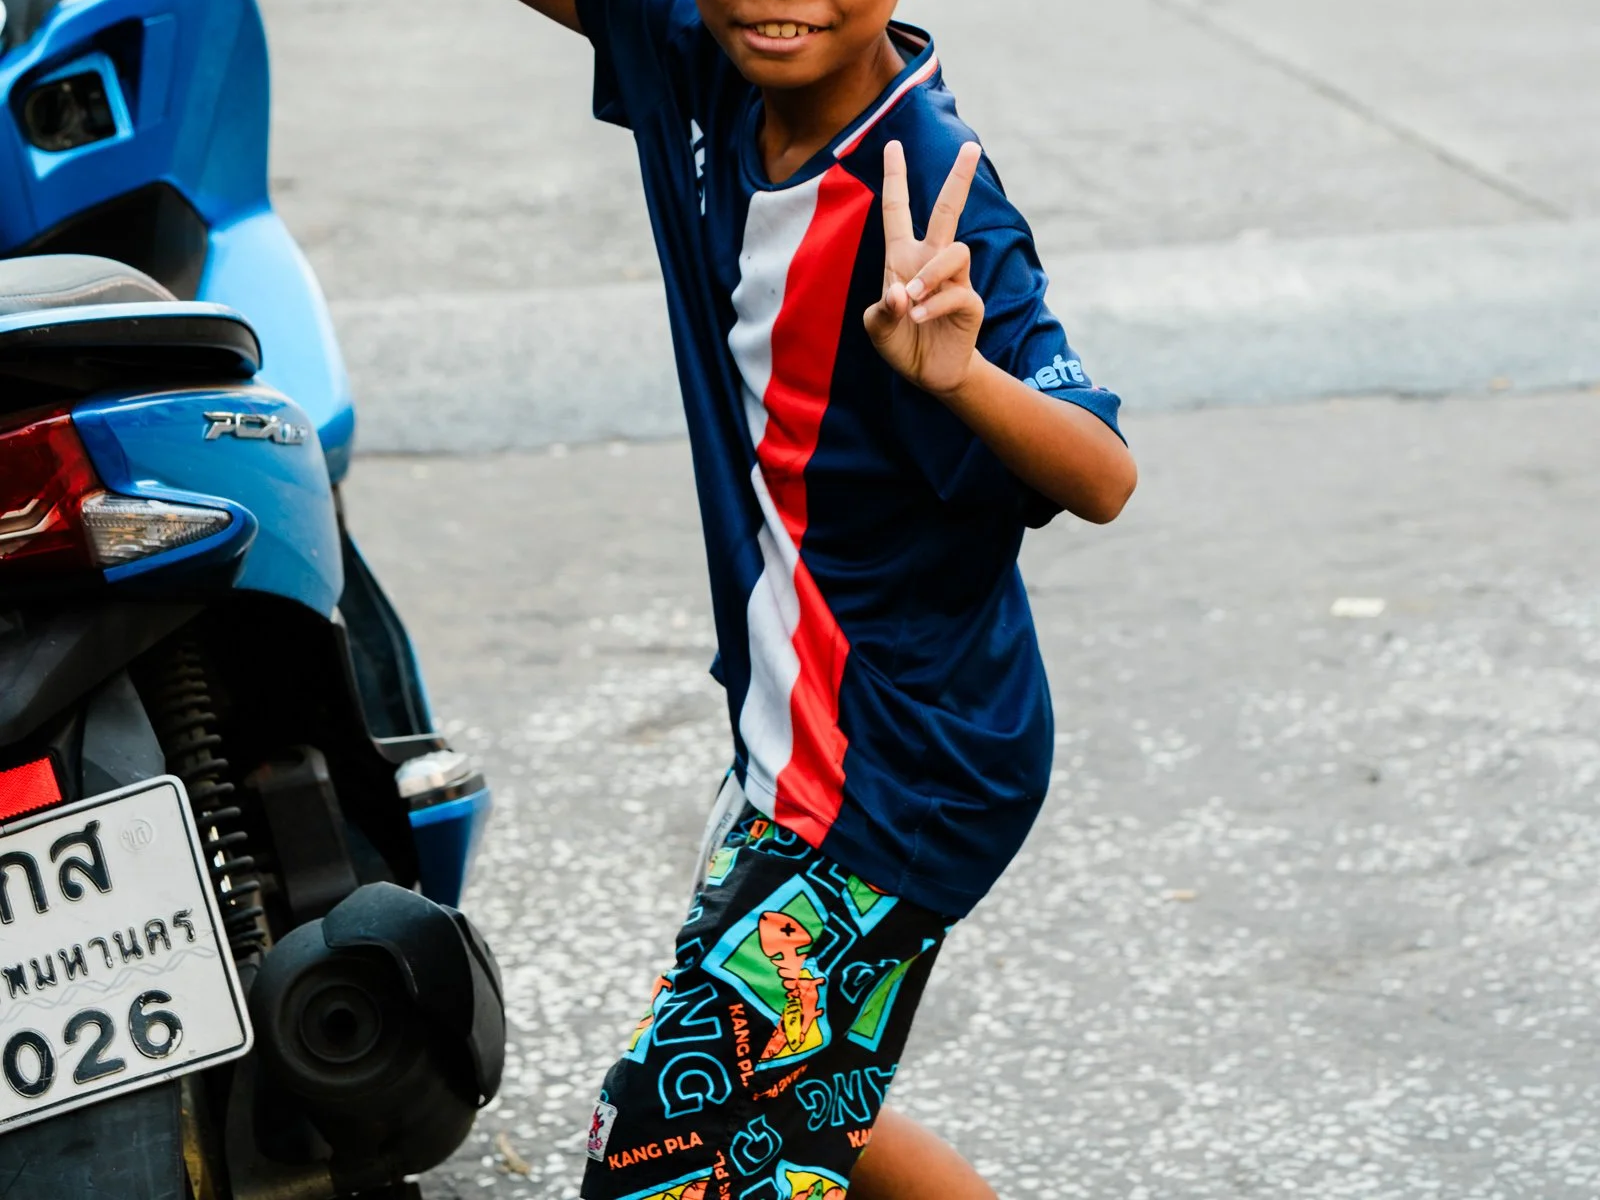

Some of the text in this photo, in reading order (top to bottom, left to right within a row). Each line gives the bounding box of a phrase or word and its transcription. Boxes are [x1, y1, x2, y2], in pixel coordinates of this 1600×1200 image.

[0, 819, 113, 925] กส
[3, 988, 184, 1099] 026
[728, 1002, 755, 1088] KANG PL
[607, 1142, 663, 1171] KANG
[663, 1131, 704, 1155] PLA
